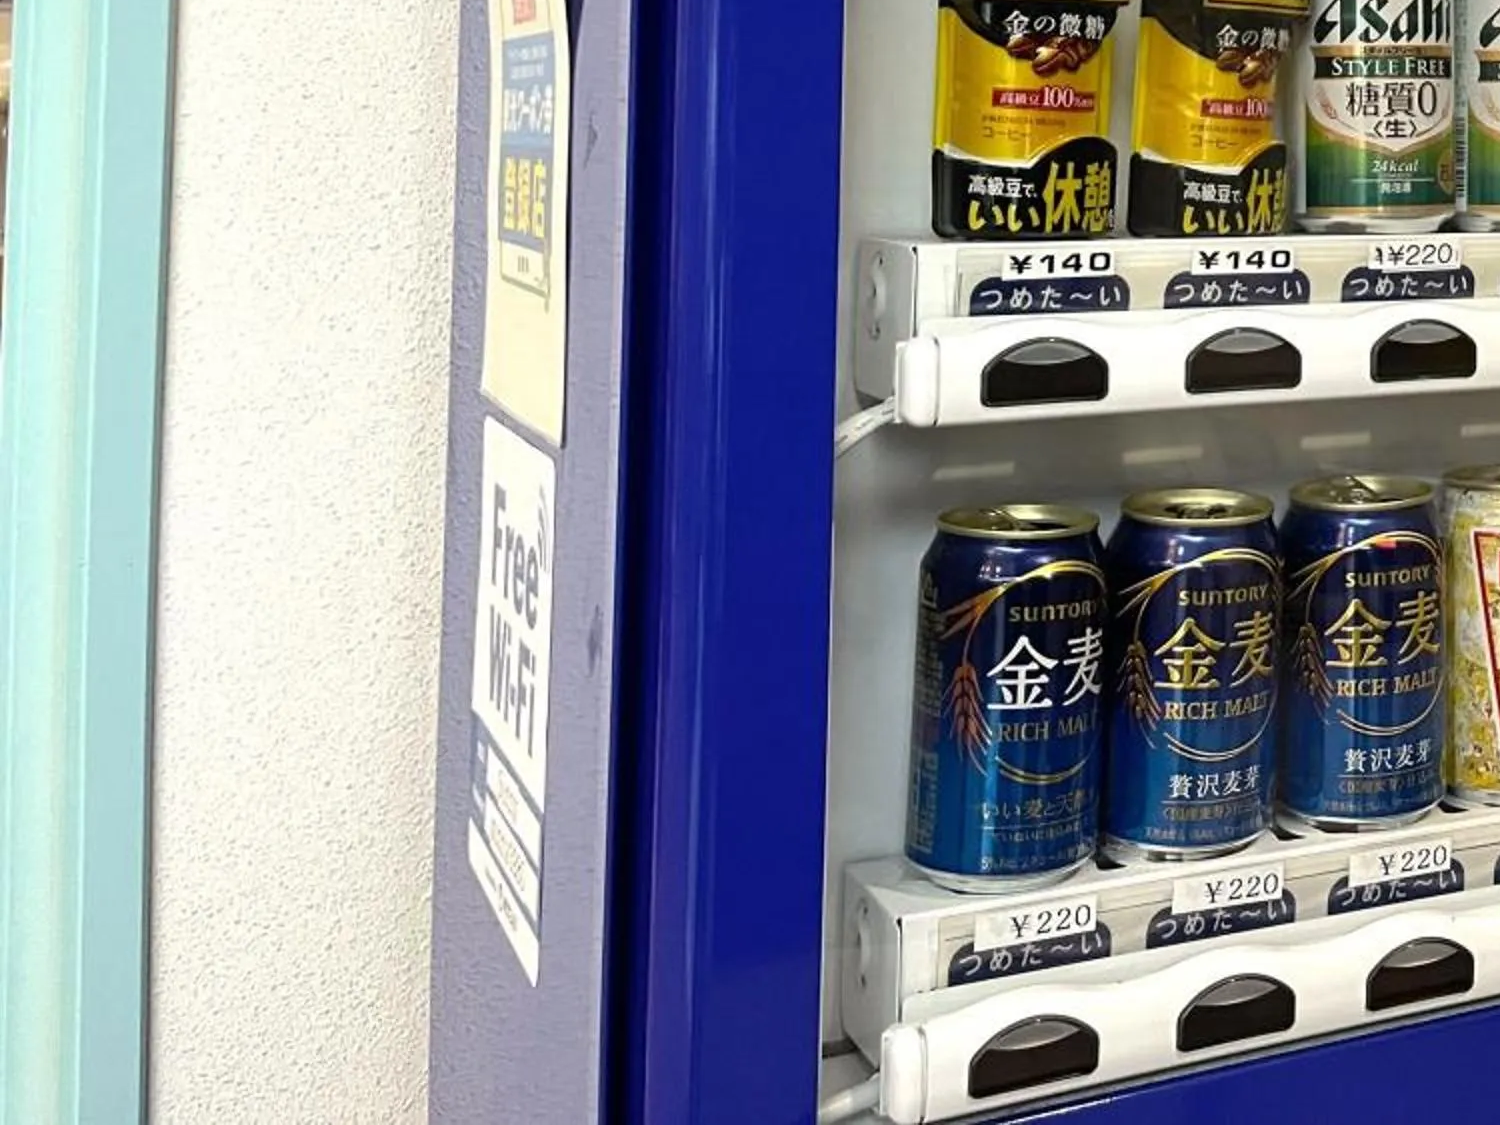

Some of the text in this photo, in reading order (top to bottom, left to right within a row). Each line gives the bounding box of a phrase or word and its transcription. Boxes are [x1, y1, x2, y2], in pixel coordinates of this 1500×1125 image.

[1004, 9, 1106, 41] 金の微糖
[1331, 58, 1446, 76] STYLE FREE
[1346, 82, 1439, 117] 糖質0
[1371, 159, 1419, 174] 24kcal
[1010, 252, 1111, 274] ¥140
[1199, 249, 1291, 270] ¥140
[1388, 243, 1452, 266] ¥220
[491, 481, 540, 632] Free
[1325, 591, 1441, 668] 金麦
[1153, 611, 1275, 690] 金麦
[488, 603, 536, 760] Wi-Fi
[987, 627, 1102, 710] 金麦
[1336, 670, 1438, 697] RICH MALT
[1165, 692, 1270, 721] RICH MALT
[999, 723, 1050, 742] RICH
[1344, 738, 1432, 773] 贅沢麦芽
[1170, 768, 1260, 799] 贅沢麦芽
[1381, 845, 1447, 876] ¥220
[1205, 873, 1279, 904] ¥220
[1012, 904, 1091, 939] ¥220
